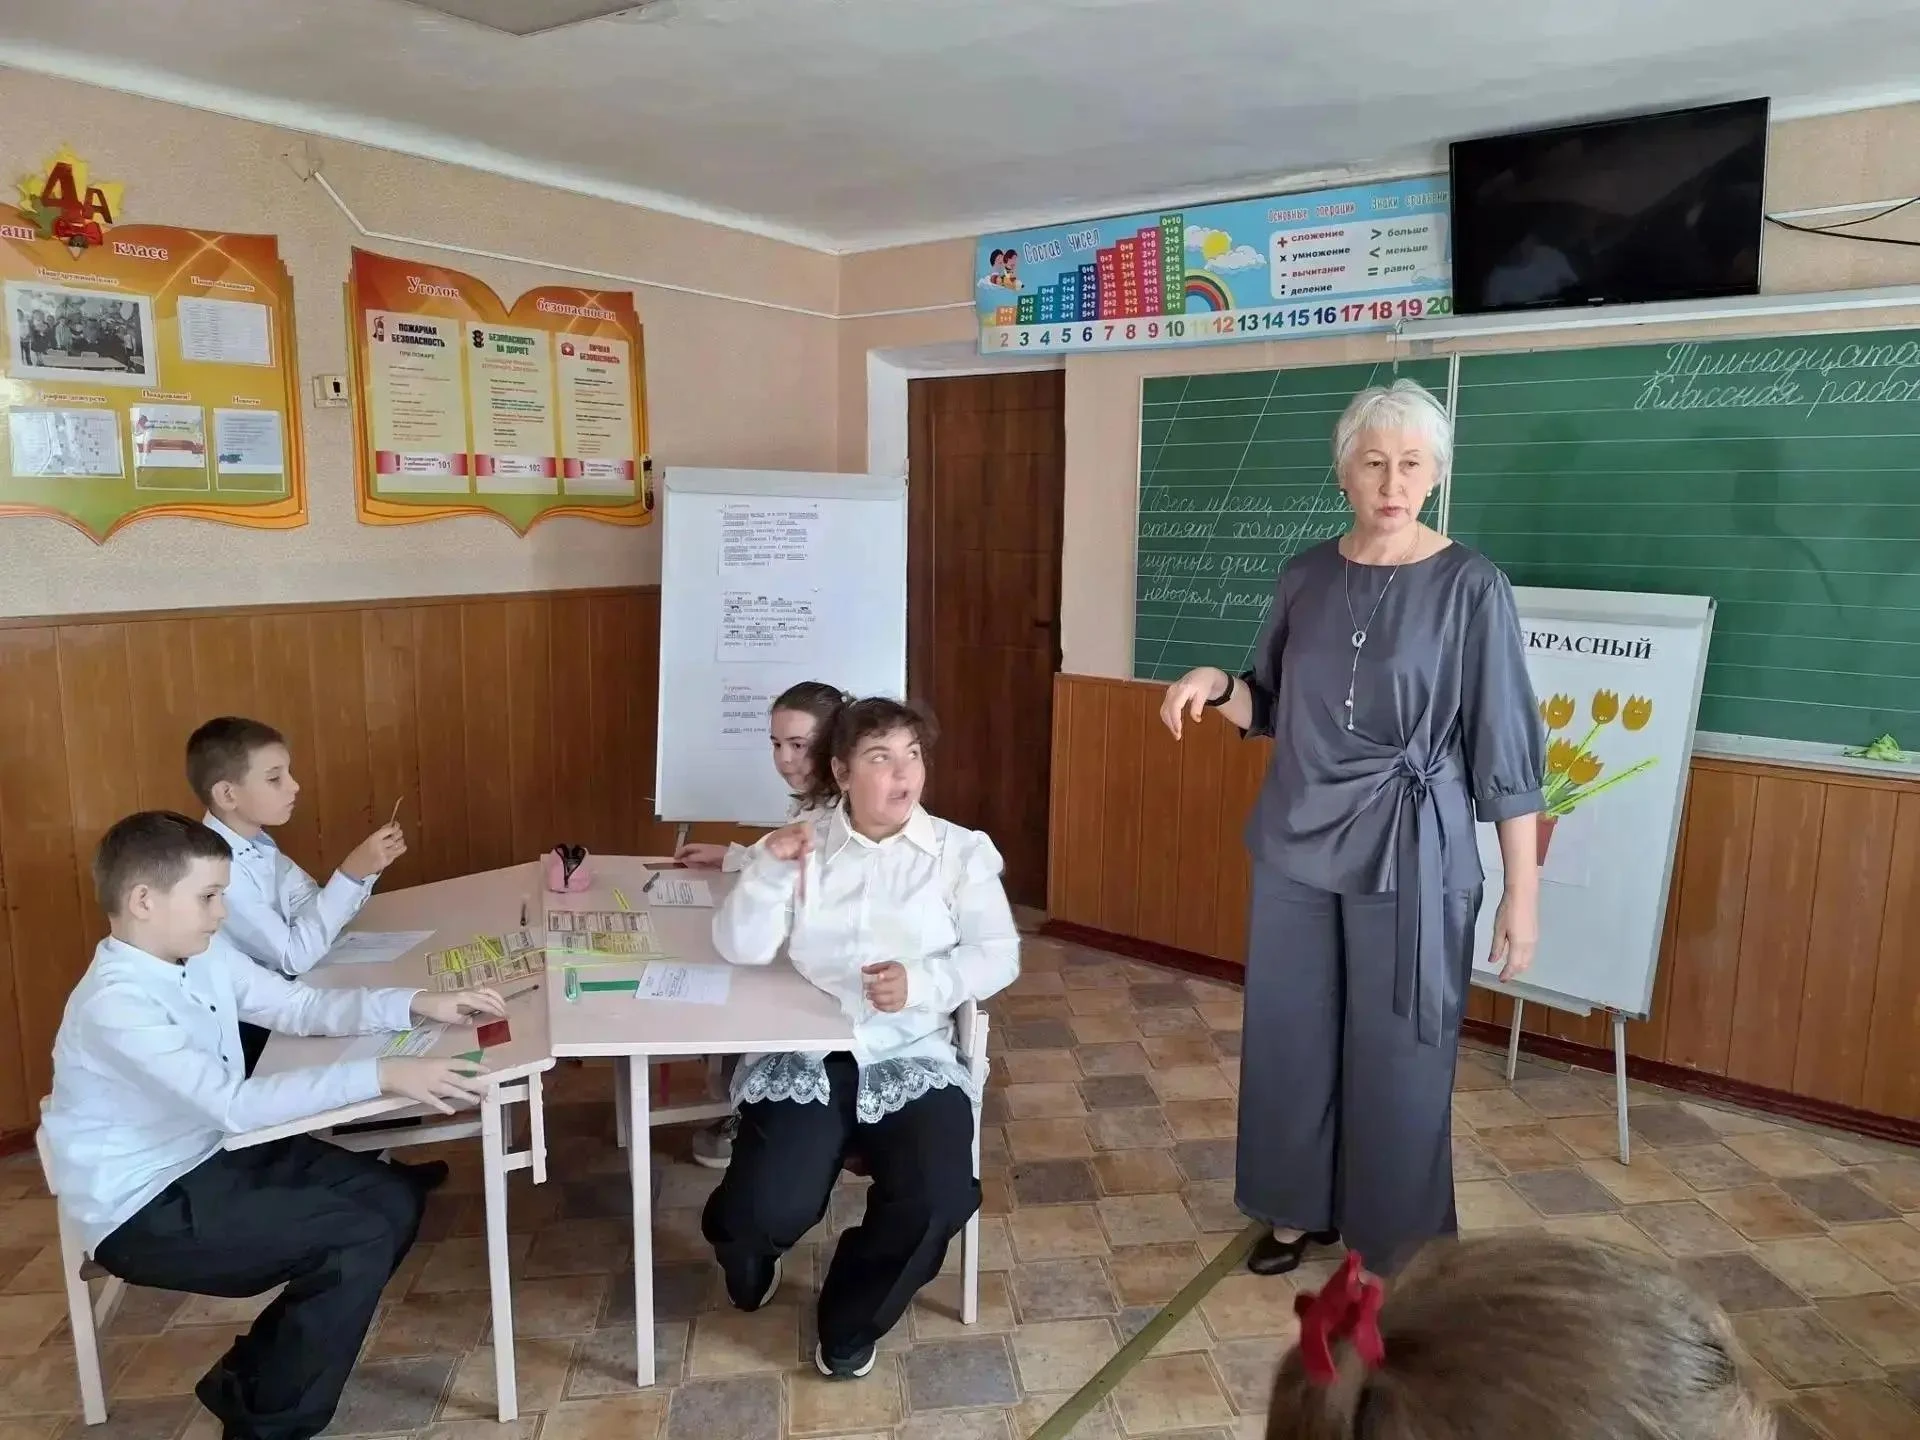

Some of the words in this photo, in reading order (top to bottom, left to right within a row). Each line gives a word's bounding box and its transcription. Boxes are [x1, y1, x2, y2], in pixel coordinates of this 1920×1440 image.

[1268, 208, 1308, 222] Основные
[1316, 202, 1355, 217] операции
[1292, 230, 1344, 242] сложение
[1388, 227, 1428, 237] больше
[1, 225, 34, 240] аш
[114, 242, 168, 260] класс
[1024, 242, 1062, 264] Состав
[1067, 228, 1100, 251] чисел
[1292, 248, 1350, 262] умножение
[1386, 245, 1428, 255] меньше
[1292, 265, 1345, 277] вычитание
[1384, 264, 1415, 275] равно
[1291, 284, 1332, 296] деление
[407, 276, 460, 299] Уголок
[536, 297, 616, 322] безопасности
[1000, 332, 1009, 347] 2
[1019, 332, 1030, 346] 3
[1040, 330, 1051, 345] 4
[1062, 328, 1071, 343] 5
[1082, 327, 1093, 342] 6
[1105, 326, 1114, 340] 7
[1126, 324, 1136, 339] 8
[1148, 322, 1158, 338] 9
[1166, 321, 1184, 337] 10
[1213, 317, 1234, 333] 12
[1238, 314, 1258, 331] 13
[1262, 312, 1283, 329] 14
[1288, 309, 1309, 327] 15
[1313, 306, 1336, 324] 16
[1340, 304, 1364, 322] 17
[1368, 301, 1392, 319] 18
[1397, 299, 1422, 316] 19
[1427, 296, 1452, 314] 20
[398, 323, 437, 336] ПОЖАРНАЯ
[391, 334, 445, 347] БЕЗОПАСНОСТЬ
[1656, 341, 1920, 396] Тринадцато
[438, 461, 451, 469] 101
[529, 464, 541, 472] 102
[1142, 521, 1215, 538] стоят
